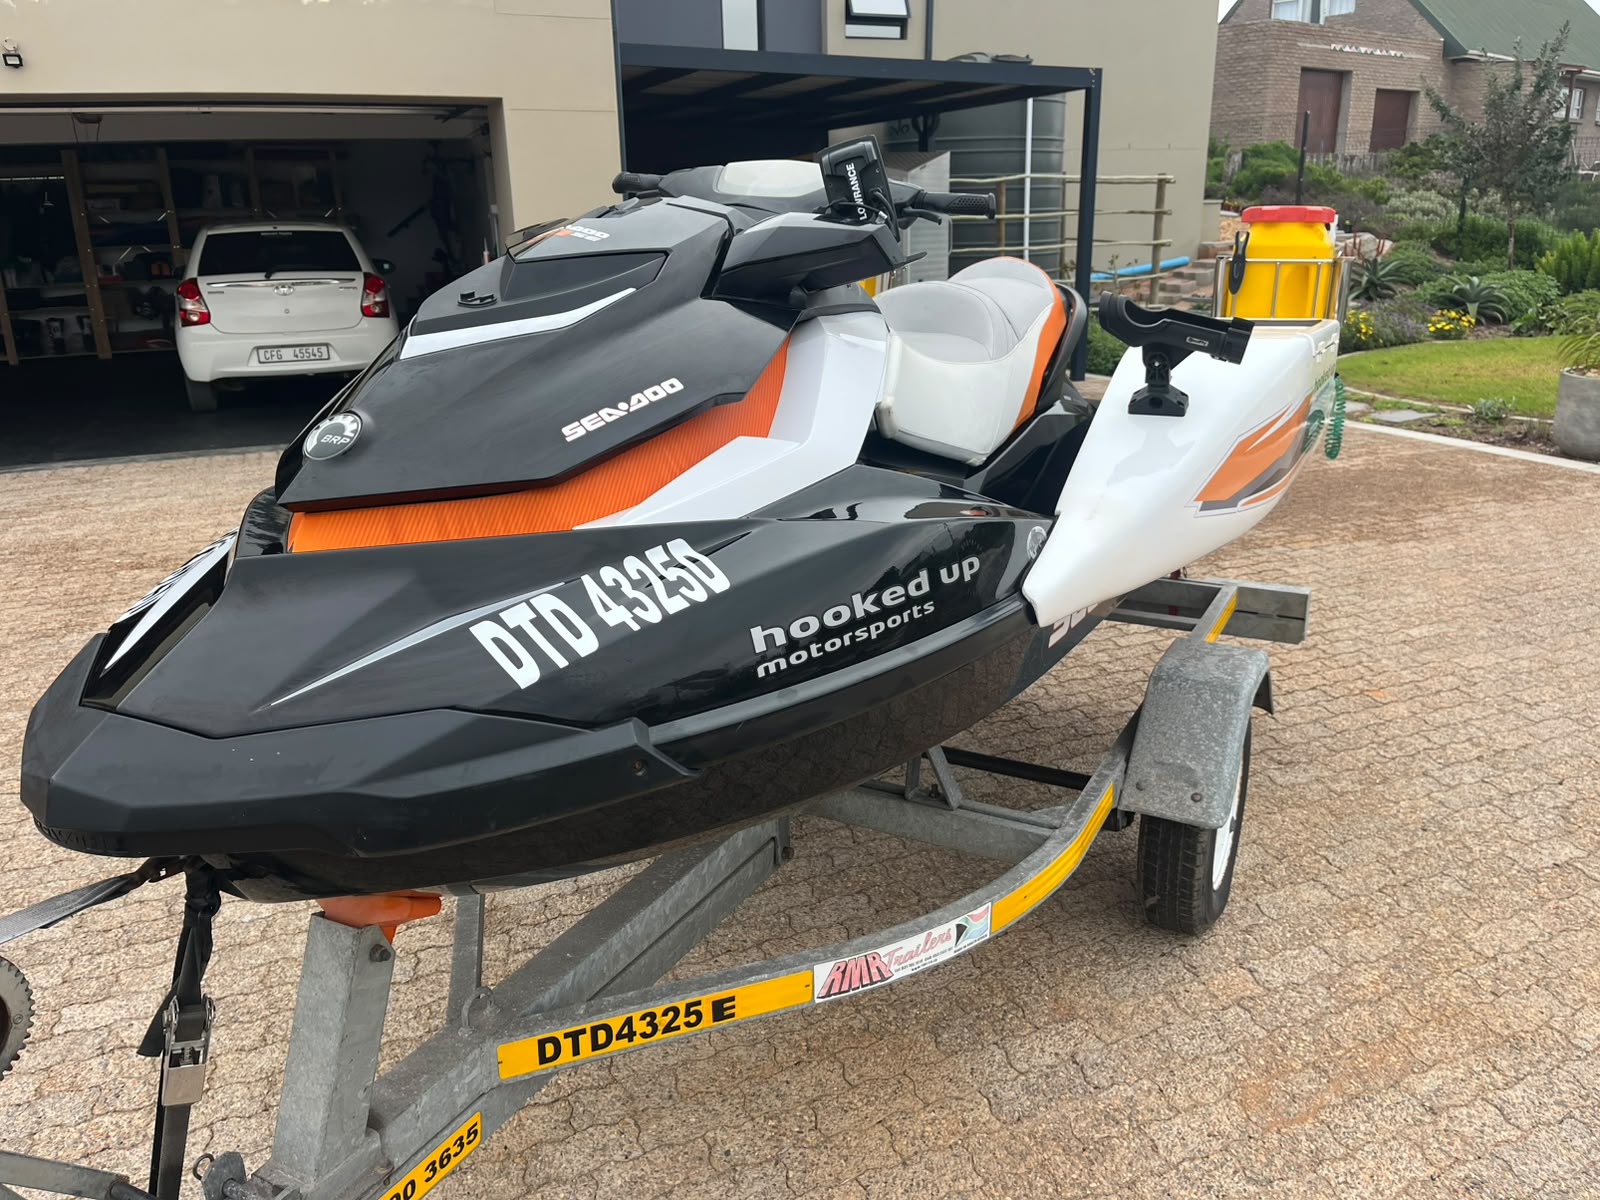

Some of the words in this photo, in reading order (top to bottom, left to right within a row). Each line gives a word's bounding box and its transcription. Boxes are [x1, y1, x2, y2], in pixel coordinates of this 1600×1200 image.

[846, 162, 868, 221] LOWRANCE
[263, 350, 283, 361] CFG
[293, 347, 323, 359] 45545
[320, 434, 351, 445] BRP
[749, 568, 931, 654] hooked
[939, 555, 981, 583] up
[468, 593, 600, 690] DTD
[755, 601, 936, 679] motorsports
[816, 951, 895, 999] RMR
[882, 927, 953, 971] Trailers
[424, 1121, 479, 1184] 3635
